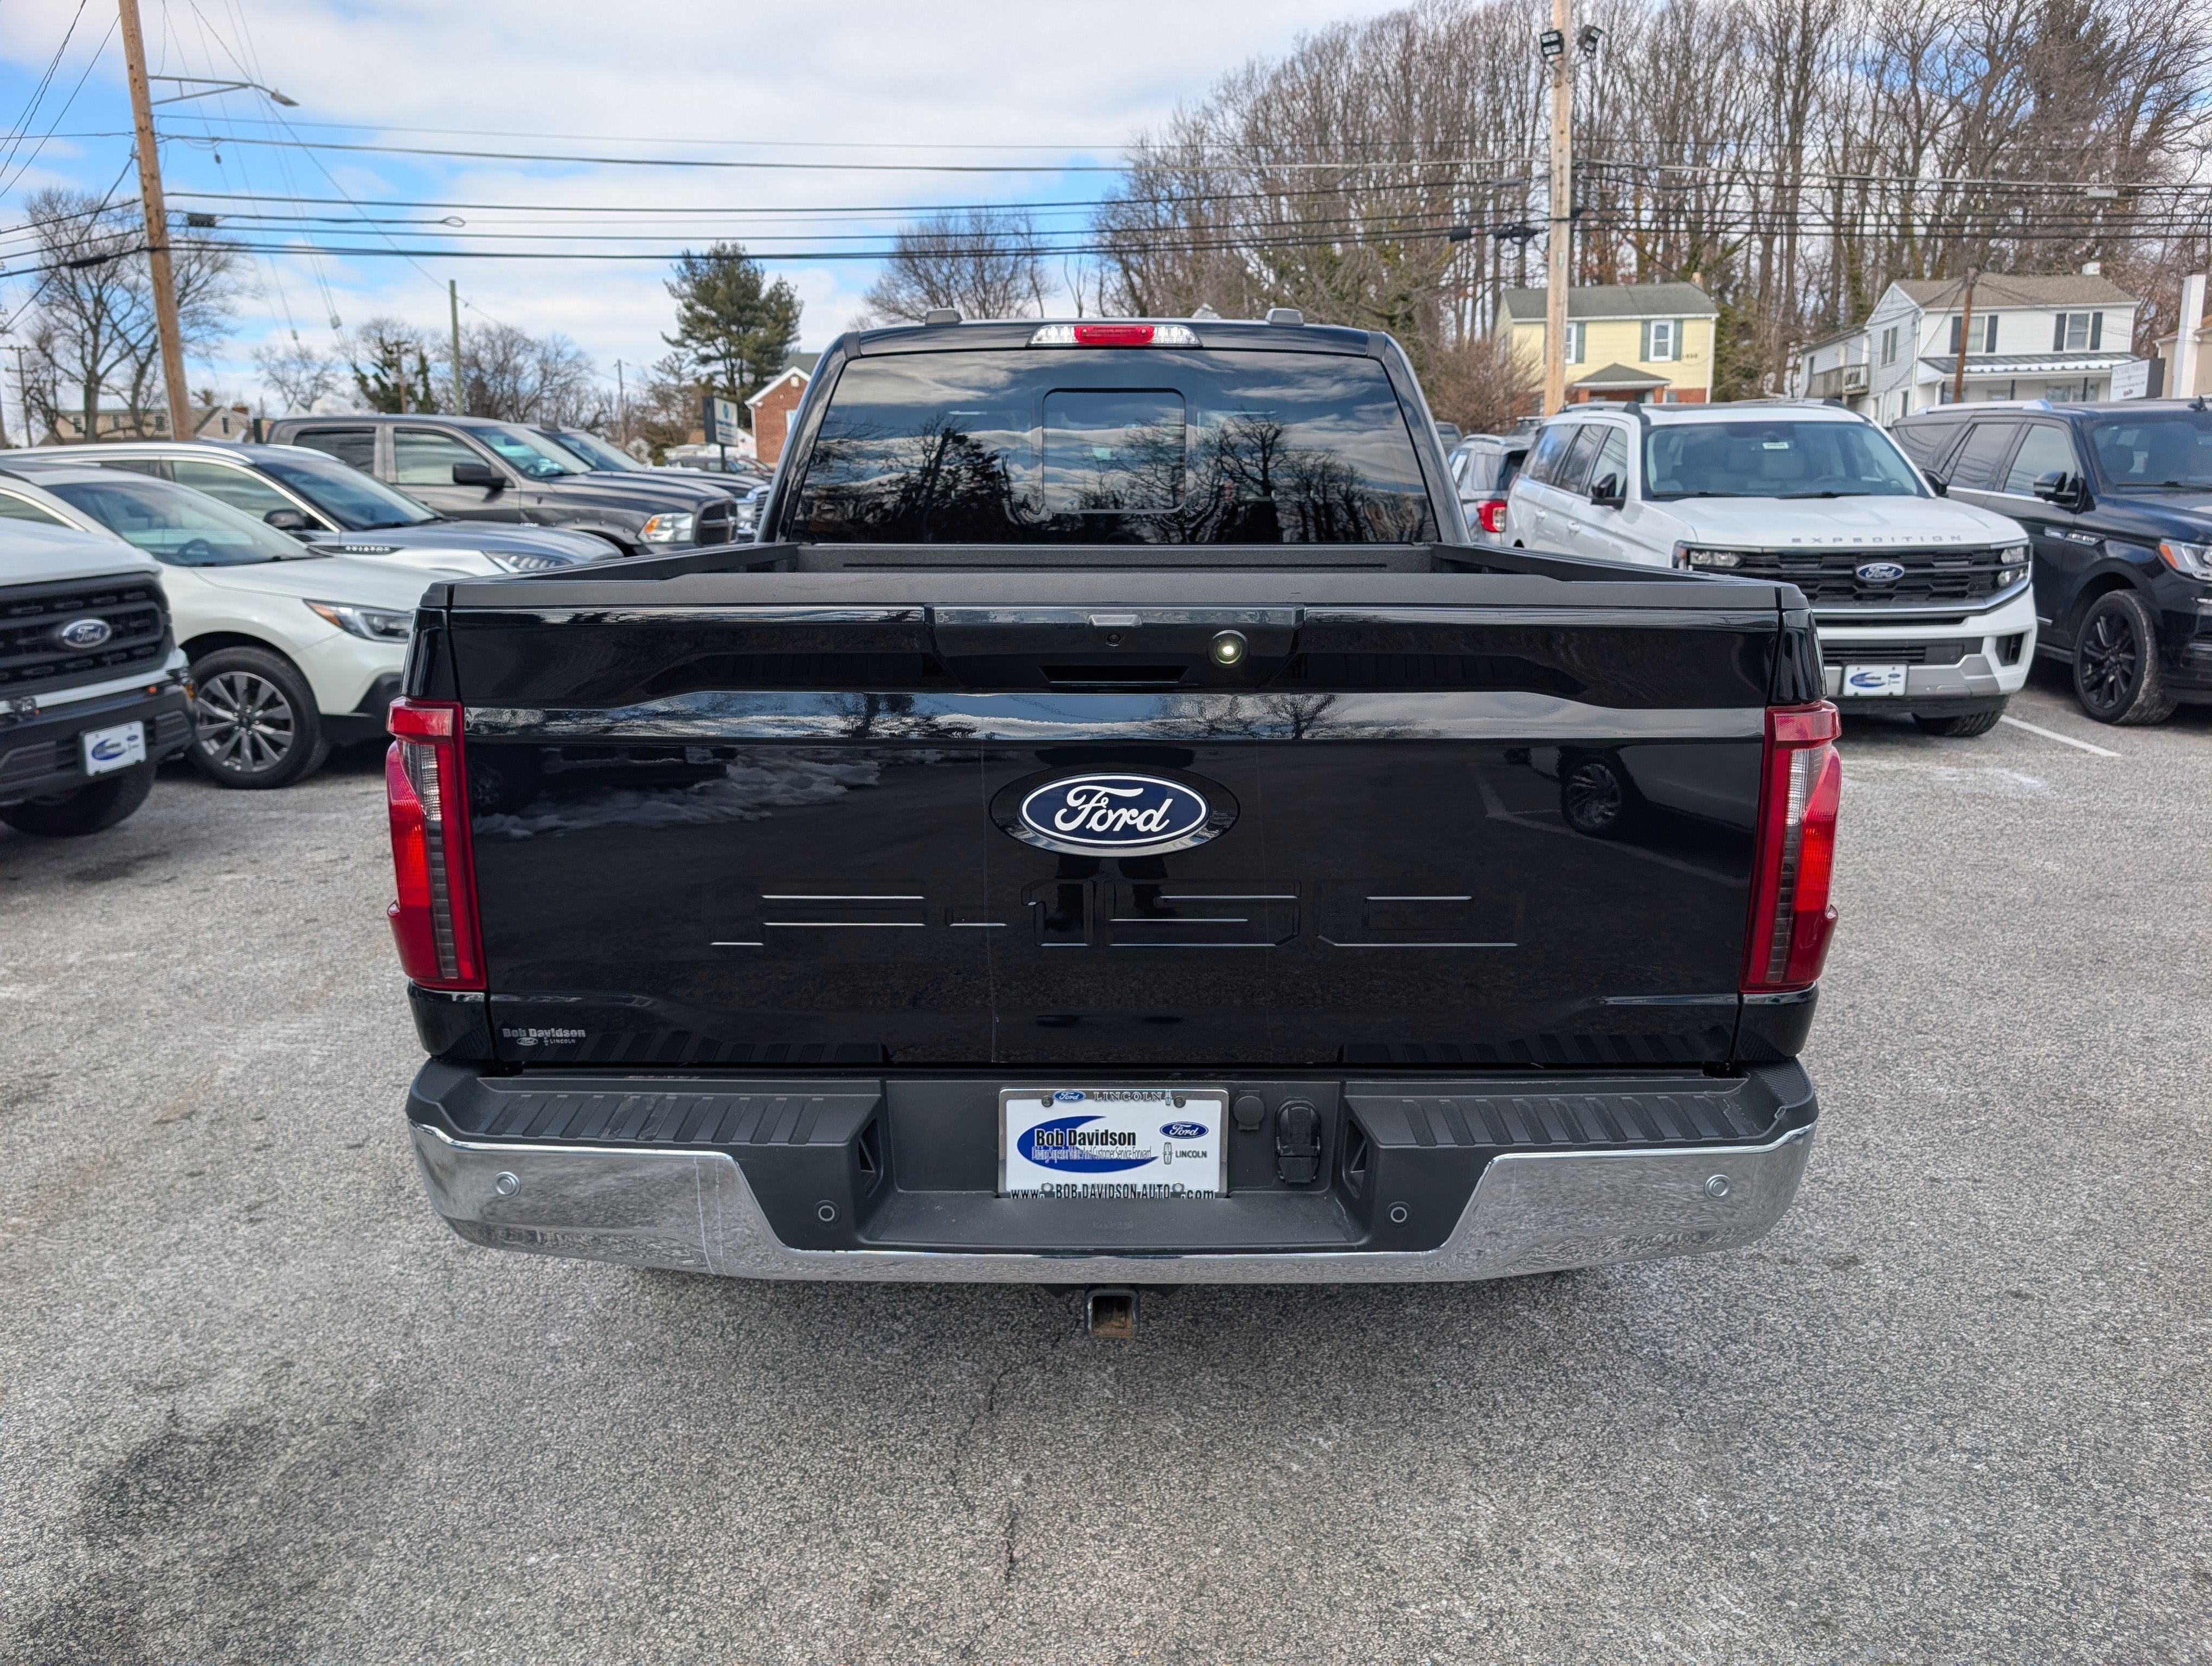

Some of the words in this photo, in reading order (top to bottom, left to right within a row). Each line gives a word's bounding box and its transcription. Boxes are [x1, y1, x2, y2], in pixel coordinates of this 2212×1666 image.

[1791, 535, 1962, 543] EXPEDITION
[1054, 785, 1174, 832] Ford
[707, 877, 1524, 947] F-150
[503, 1028, 527, 1037] Bob
[529, 1028, 586, 1037] Davidson
[1093, 1092, 1162, 1102] LINCOLN
[1169, 1124, 1199, 1136] Ford
[1036, 1129, 1064, 1146] Bob
[1068, 1129, 1136, 1146] Davidson
[1175, 1150, 1207, 1158] LINCOLN
